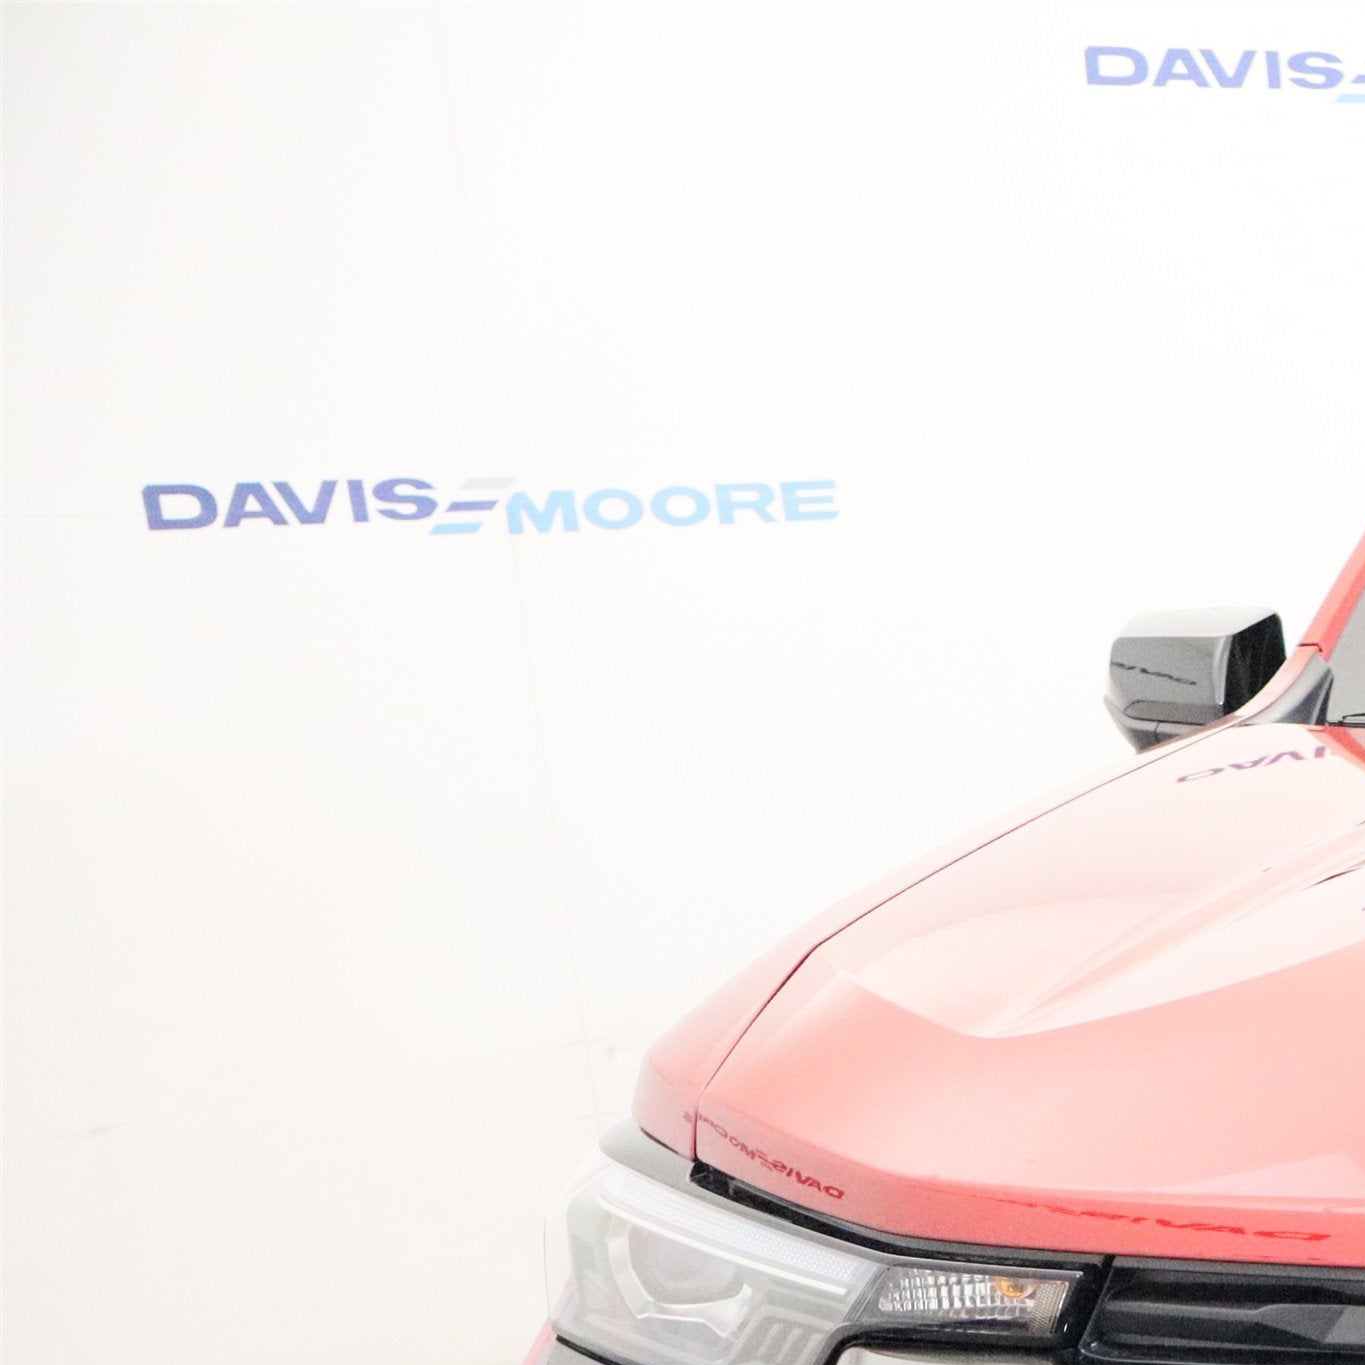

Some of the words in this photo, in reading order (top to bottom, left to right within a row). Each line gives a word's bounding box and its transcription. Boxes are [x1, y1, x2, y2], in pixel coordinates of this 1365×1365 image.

[1083, 45, 1345, 90] DAVIS
[141, 476, 439, 531] DAVIS
[505, 480, 840, 535] MOORE
